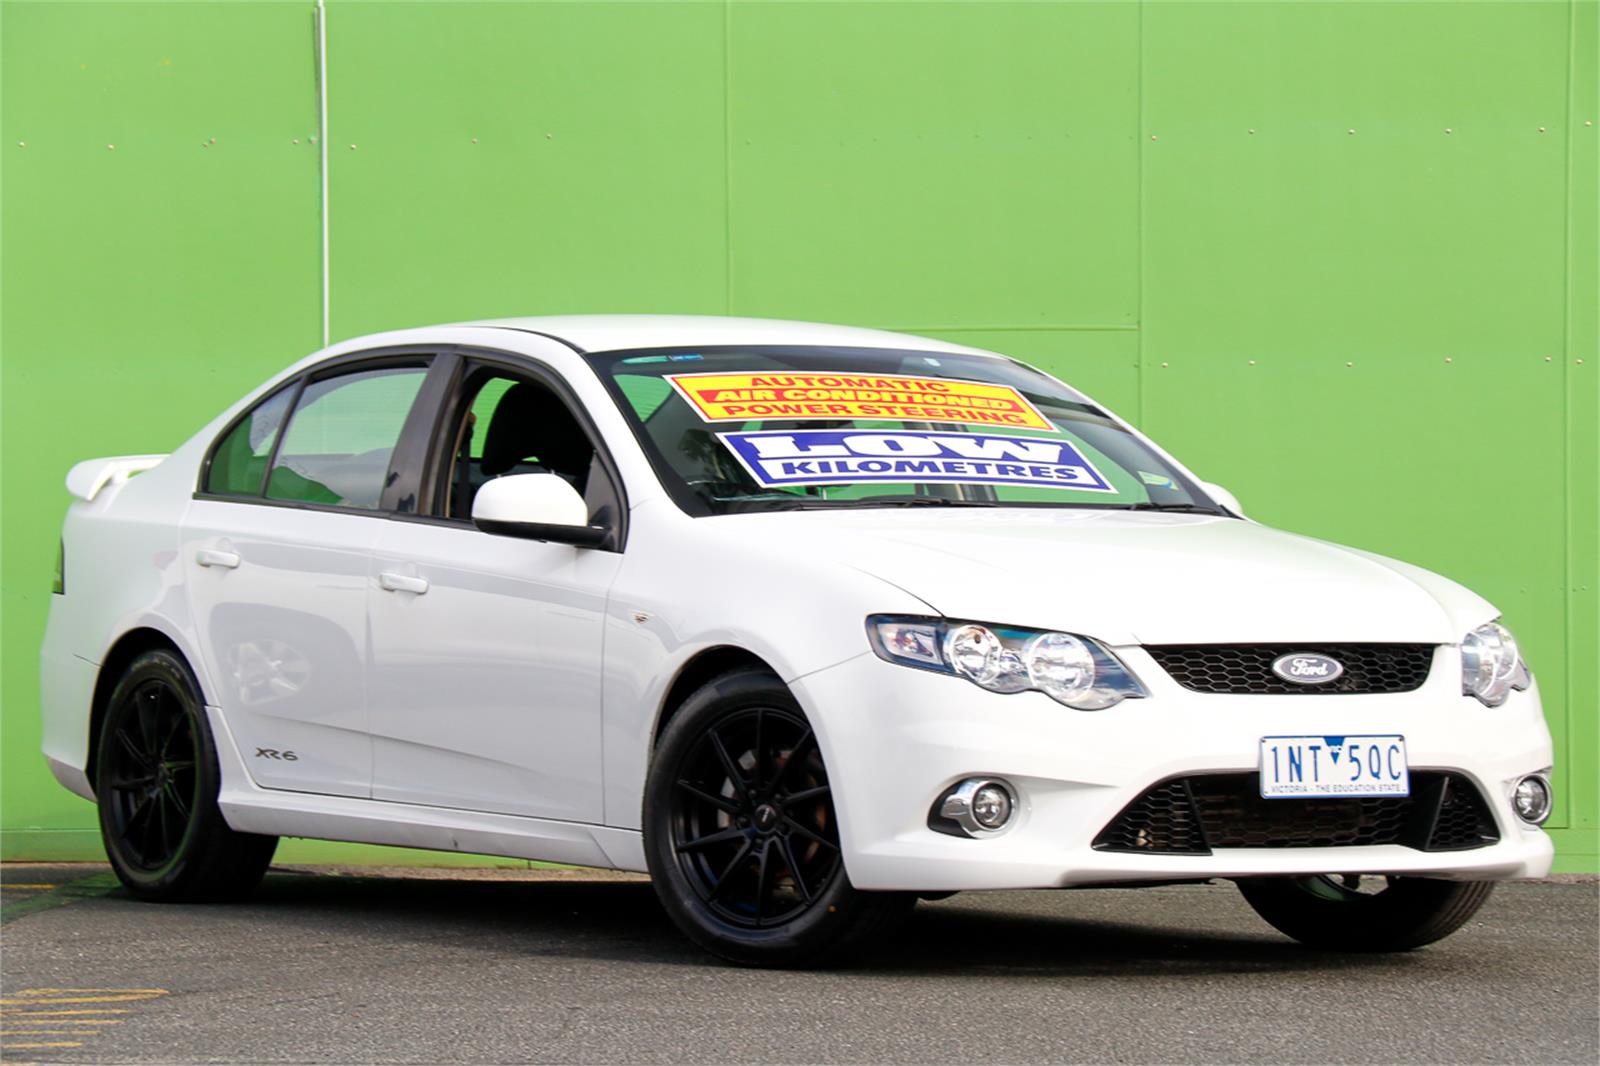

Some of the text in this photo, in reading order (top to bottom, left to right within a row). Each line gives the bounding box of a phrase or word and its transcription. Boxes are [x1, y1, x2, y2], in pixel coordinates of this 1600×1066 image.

[751, 376, 950, 393] AUTOMATIC
[714, 389, 1016, 411] AIR CONDITIONED
[722, 403, 1028, 425] POWER STEERING
[743, 433, 1064, 464] LOW
[781, 459, 1079, 481] KILOMETRES
[1290, 658, 1329, 677] Ford
[255, 747, 298, 761] XR6
[1271, 785, 1308, 793] VICTORIA
[1315, 784, 1330, 793] THE
[1333, 784, 1376, 793] EDUCATION
[1379, 783, 1400, 792] STATE
